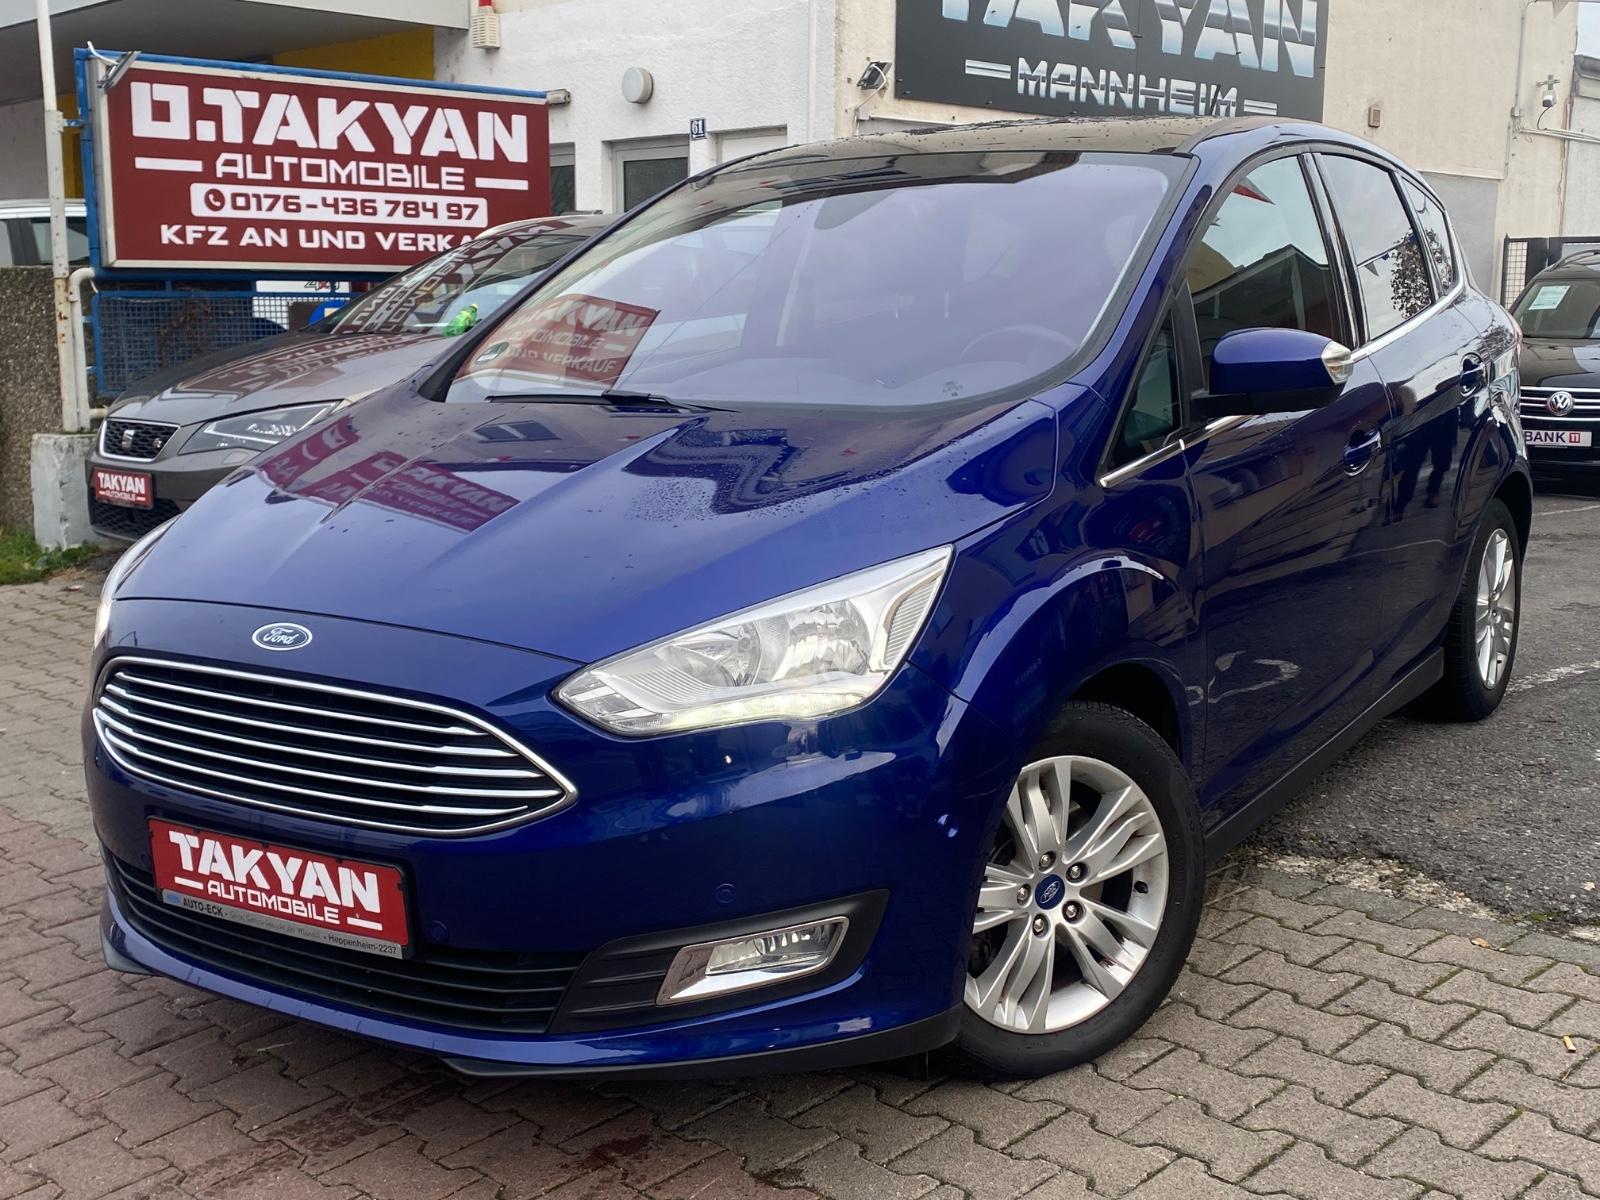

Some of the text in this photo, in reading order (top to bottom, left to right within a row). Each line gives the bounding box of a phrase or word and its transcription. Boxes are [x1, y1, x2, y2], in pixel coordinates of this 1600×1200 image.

[1016, 57, 1238, 117] MANNHEIM
[691, 120, 704, 134] 61
[216, 153, 465, 191] AUTOMOBILE
[384, 199, 438, 220] 784
[446, 203, 480, 221] 97
[160, 224, 229, 246] KFZ
[239, 227, 289, 247] AN
[300, 229, 366, 250] UND
[97, 472, 145, 494] TAKYAN
[262, 627, 300, 645] Ford
[169, 830, 381, 913] TAKYAN
[182, 897, 223, 917] AUTO-ECK
[207, 879, 341, 924] AUTOMOBILE
